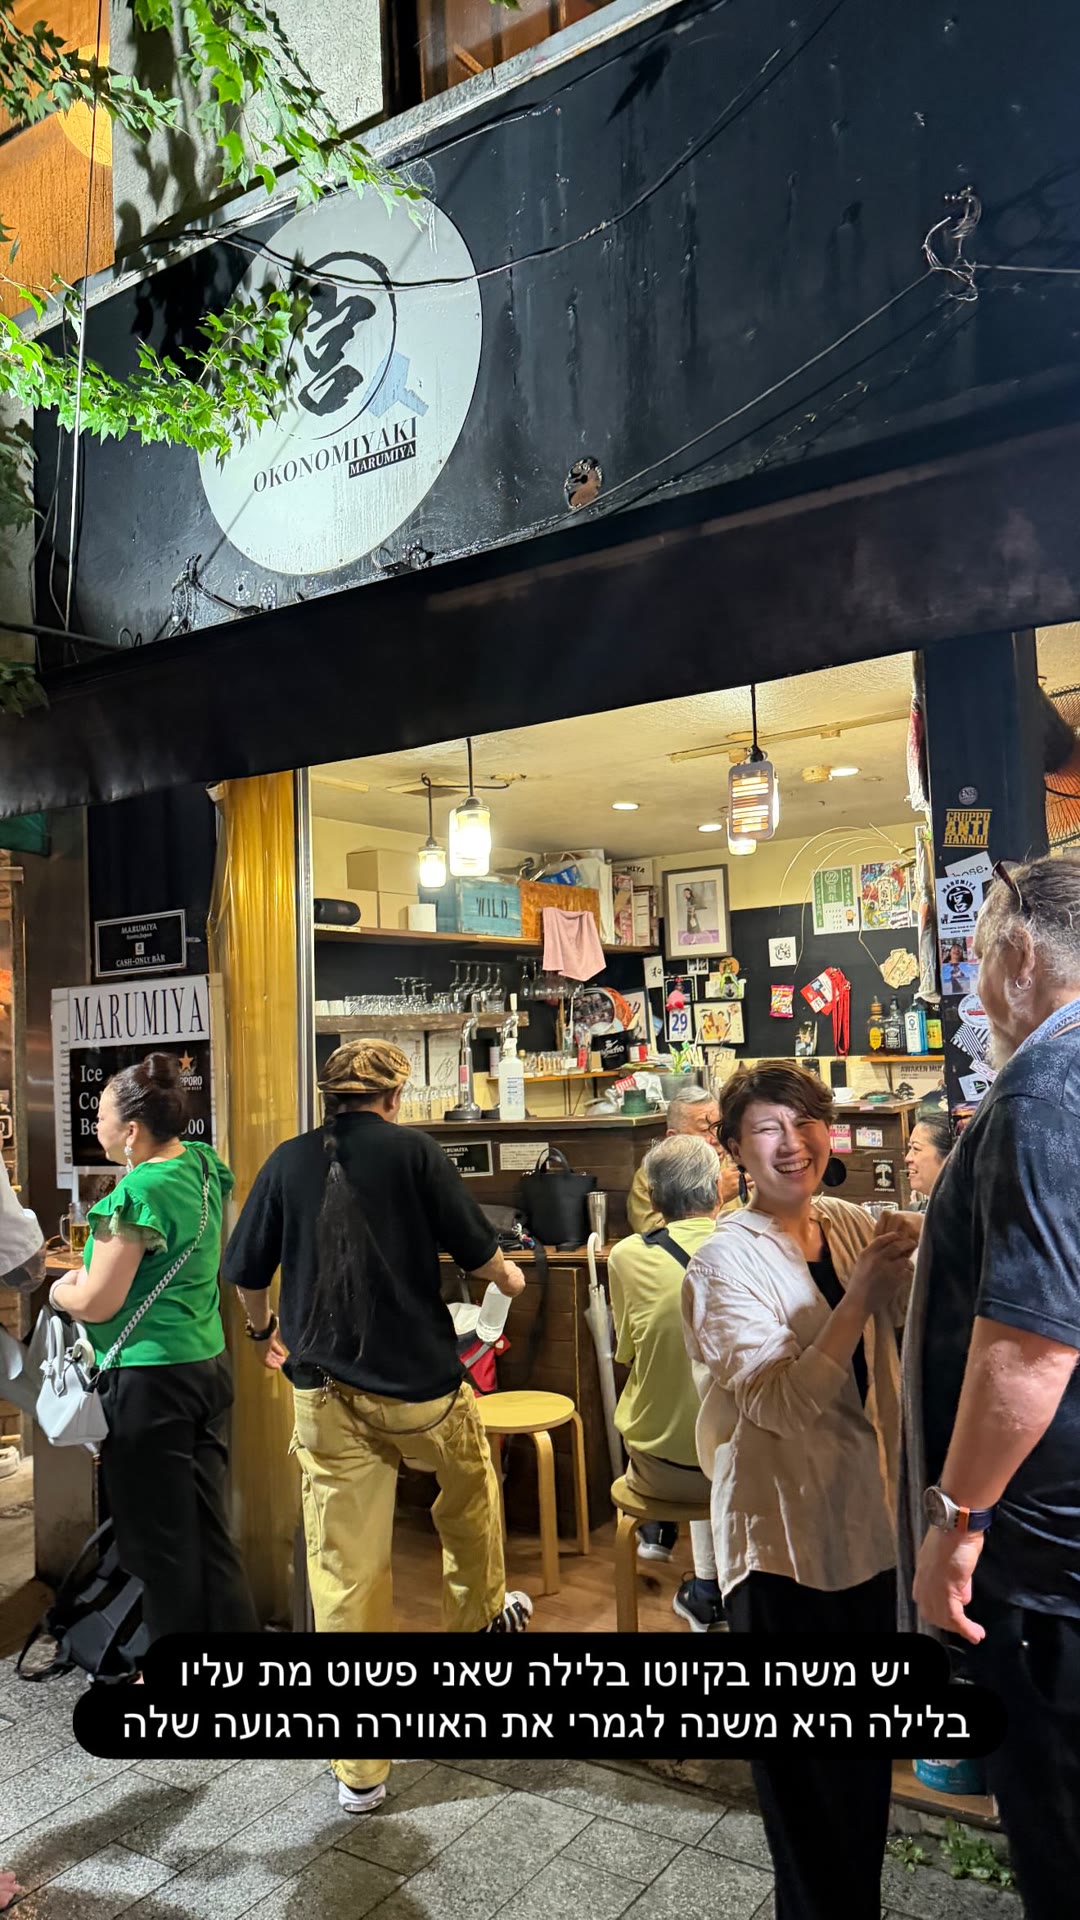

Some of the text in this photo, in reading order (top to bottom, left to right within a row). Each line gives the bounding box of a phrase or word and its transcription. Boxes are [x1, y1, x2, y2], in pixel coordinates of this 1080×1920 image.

[253, 416, 419, 493] OKONOMIYAKI
[350, 442, 415, 476] MARUMIYA
[945, 820, 990, 836] ANTI
[941, 879, 977, 894] MARUMIYA
[476, 897, 508, 919] WILD
[121, 922, 158, 934] MARUMIYA
[116, 957, 150, 968] CASH-ONLY
[74, 985, 206, 1042] MARUMIYA
[671, 1012, 688, 1032] 29
[80, 1065, 103, 1083] Ice
[79, 1091, 103, 1110] Co
